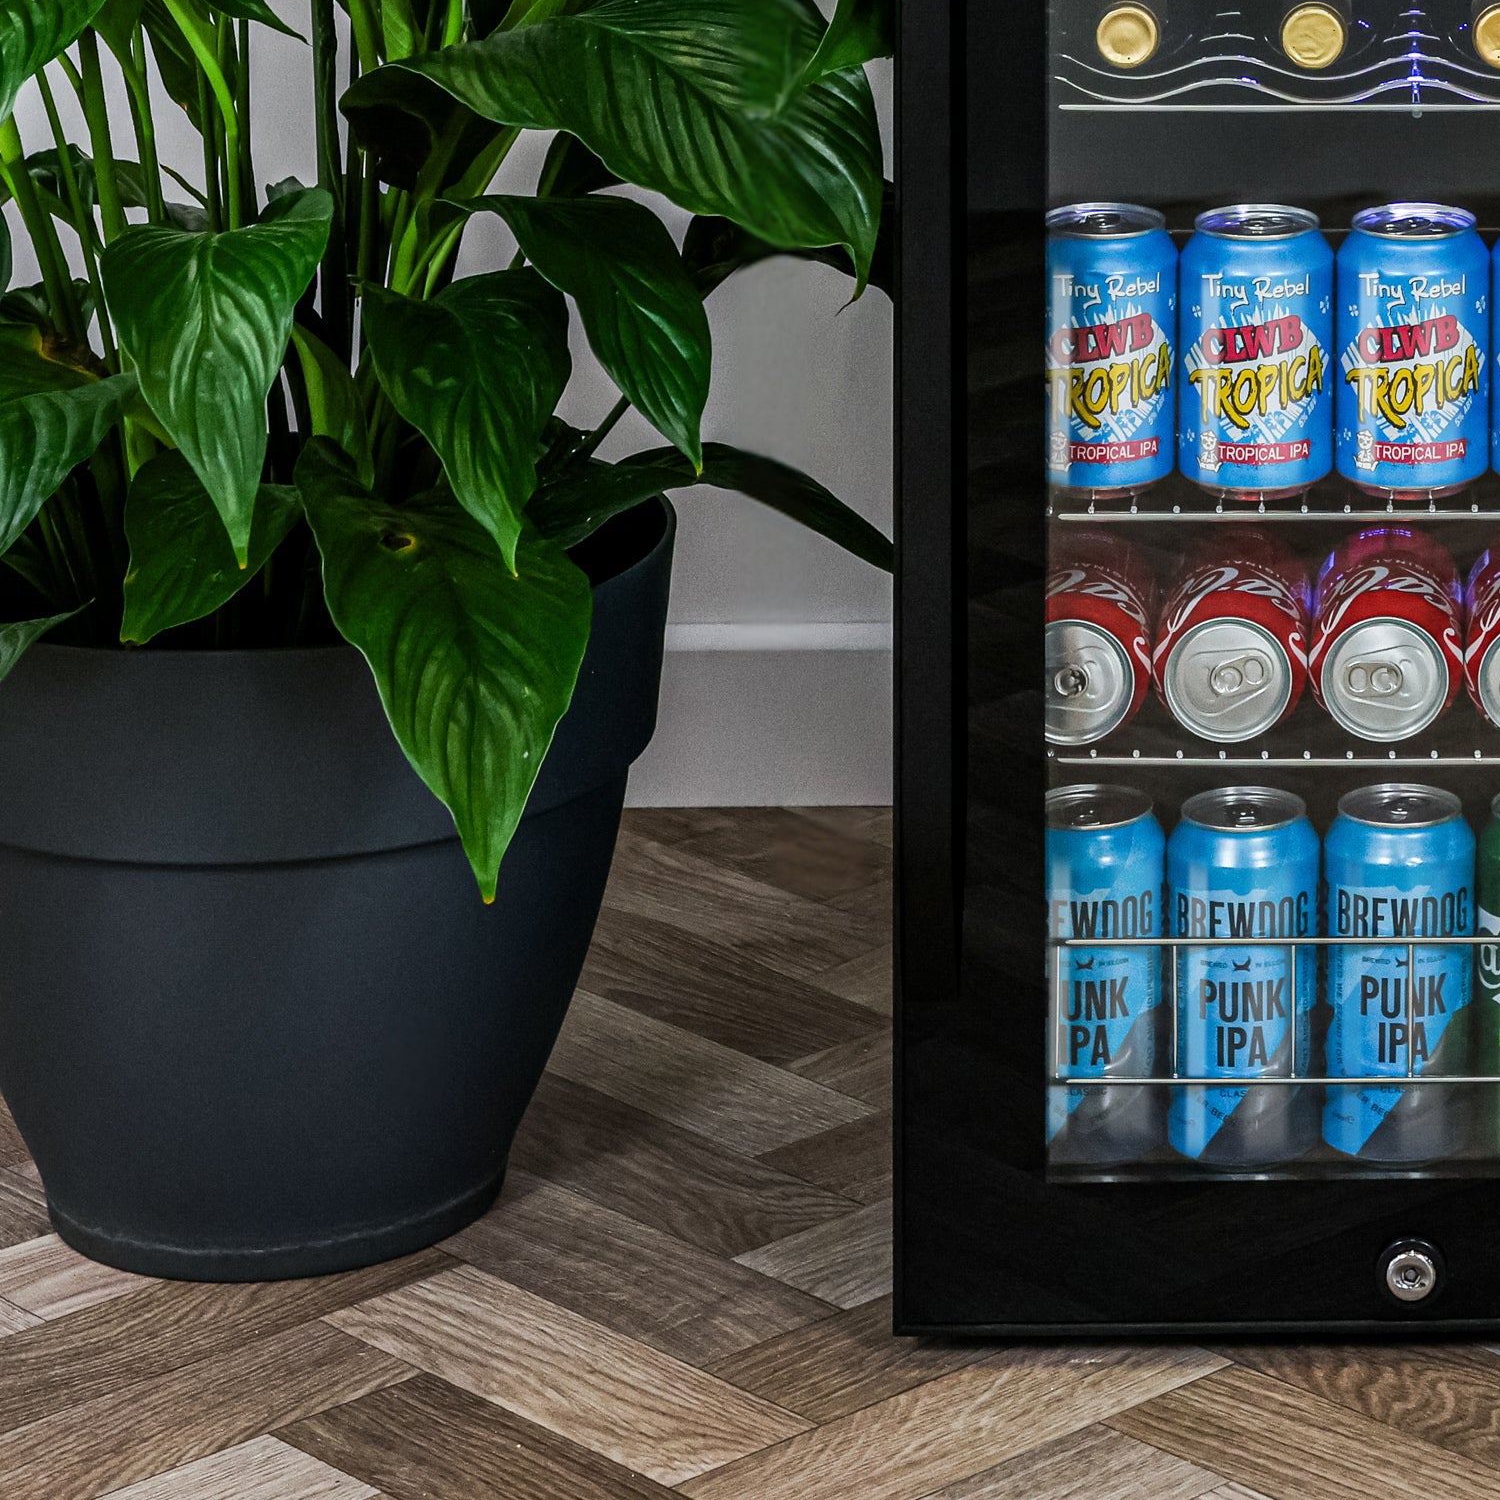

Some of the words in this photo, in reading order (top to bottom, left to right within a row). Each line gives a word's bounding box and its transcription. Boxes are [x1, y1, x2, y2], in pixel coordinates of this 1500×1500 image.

[1053, 274, 1101, 309] Tiny
[1105, 272, 1160, 301] Rebel
[1201, 273, 1249, 311] Tiny
[1252, 273, 1310, 301] Rebel
[1358, 272, 1406, 311] Tiny
[1408, 274, 1466, 301] Rebel
[1052, 312, 1155, 366] CLWB
[1201, 314, 1304, 365] CLWB
[1358, 314, 1460, 365] CLWB
[1045, 341, 1171, 430] TROPICA
[1189, 344, 1323, 430] TROPICA
[1345, 344, 1480, 430] TROPICA
[1069, 445, 1136, 460] TROPICAL
[1140, 440, 1158, 456] IPA
[1217, 445, 1285, 461] TROPICAL
[1290, 442, 1309, 458] IPA
[1375, 444, 1442, 461] TROPICAL
[1446, 443, 1465, 458] IPA
[1052, 890, 1153, 938] EWDOG
[1177, 890, 1308, 938] BREWDOG
[1337, 886, 1468, 937] BREWDOG
[1061, 976, 1130, 1021] UNK
[1199, 977, 1287, 1023] PUNK
[1360, 972, 1447, 1019] PUNK
[1059, 1024, 1112, 1066] IPA
[1216, 1026, 1268, 1068] IPA
[1378, 1022, 1429, 1064] IPA
